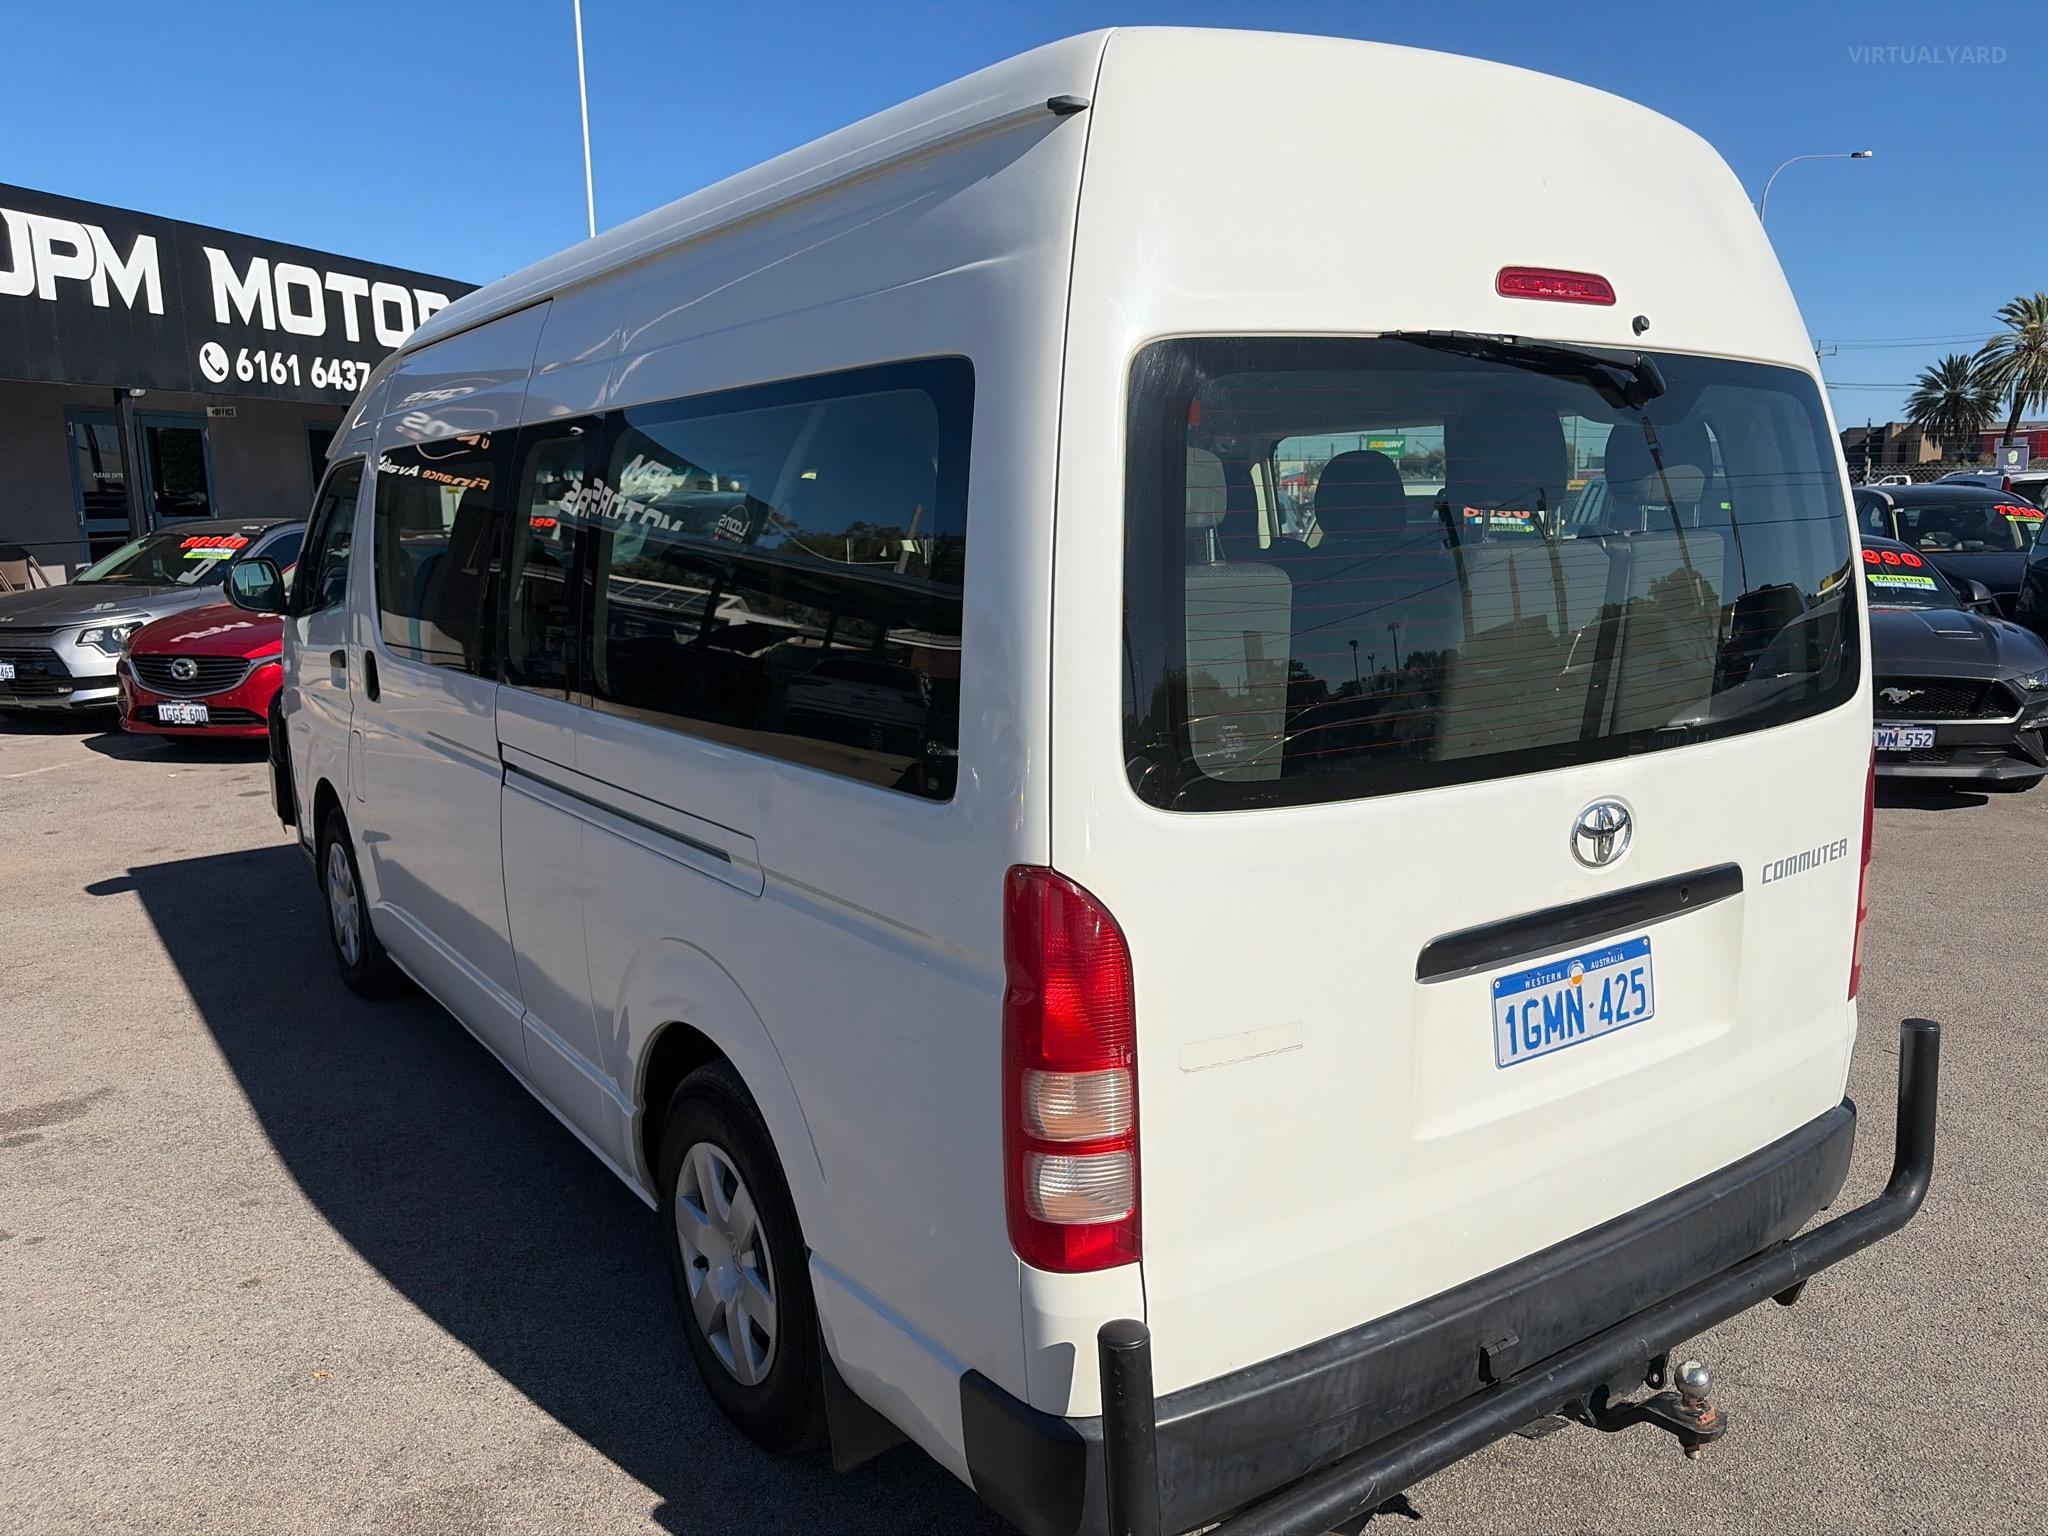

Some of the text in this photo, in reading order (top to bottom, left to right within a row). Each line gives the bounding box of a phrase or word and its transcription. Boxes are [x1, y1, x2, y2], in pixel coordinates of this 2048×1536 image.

[236, 348, 371, 393] 6161 6437
[1875, 575, 1927, 583] Manual
[1762, 838, 1848, 885] COMMUTER
[1525, 952, 1625, 989] WESTERN AUSTRALIA
